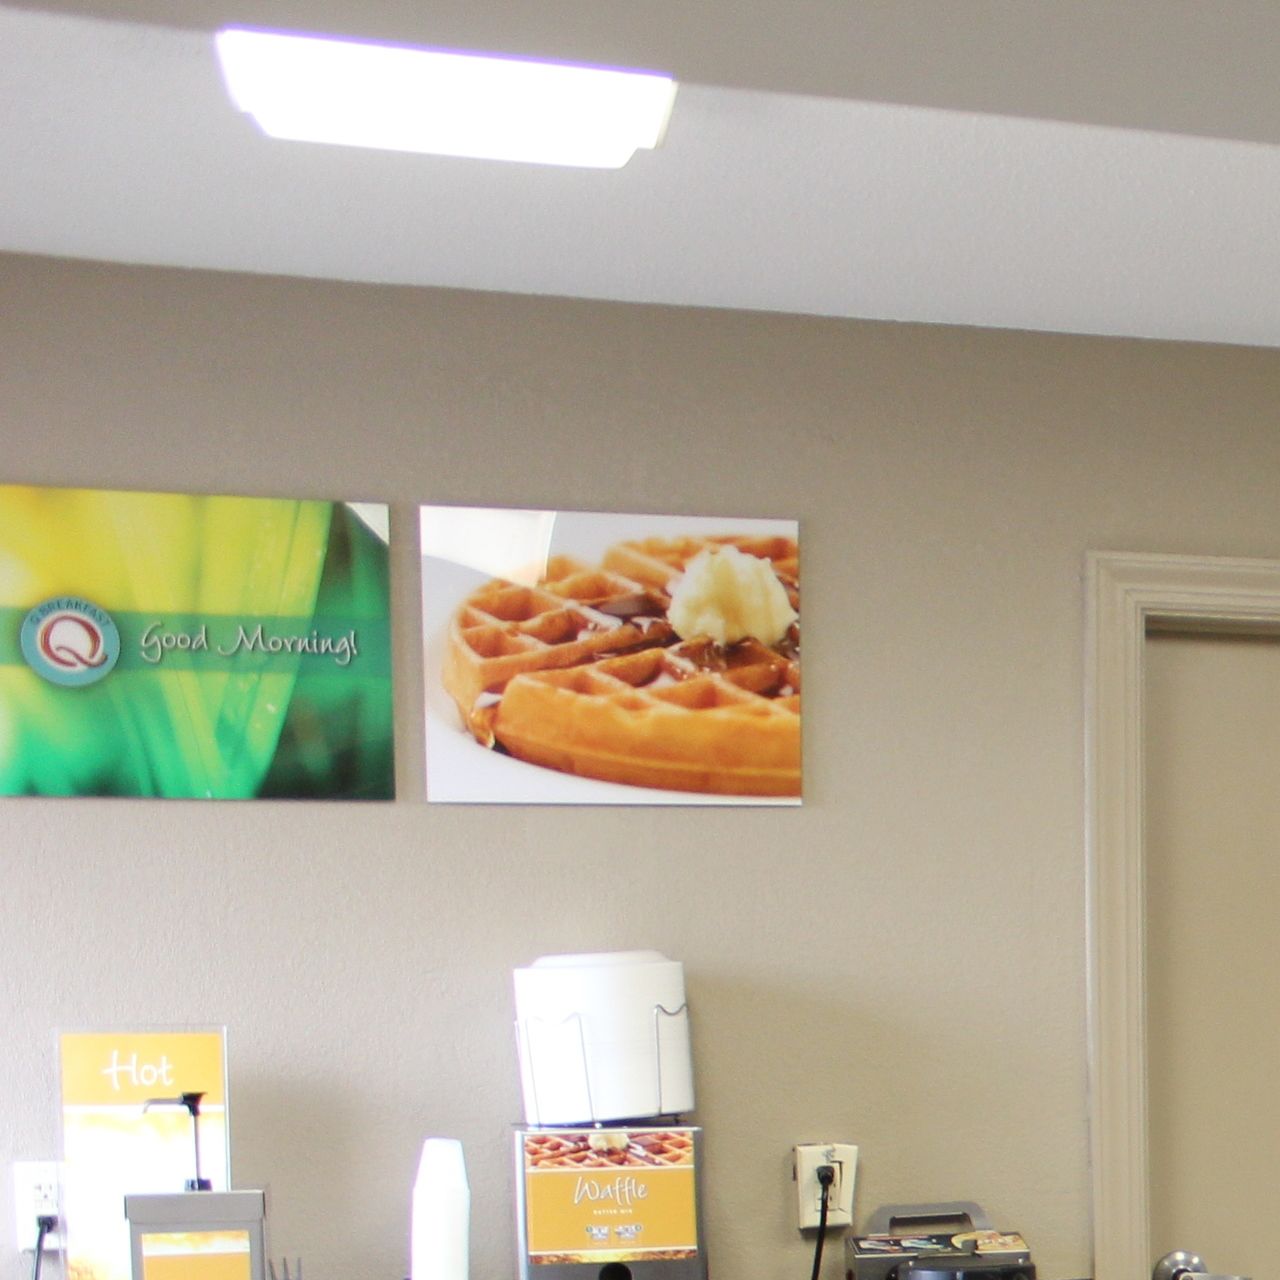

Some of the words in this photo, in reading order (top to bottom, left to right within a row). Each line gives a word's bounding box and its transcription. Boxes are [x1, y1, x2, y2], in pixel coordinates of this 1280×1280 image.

[40, 614, 109, 669] Q
[141, 621, 209, 664] Good
[217, 623, 358, 666] Morning!
[101, 1049, 176, 1092] Hot
[573, 1175, 649, 1206] Waffle
